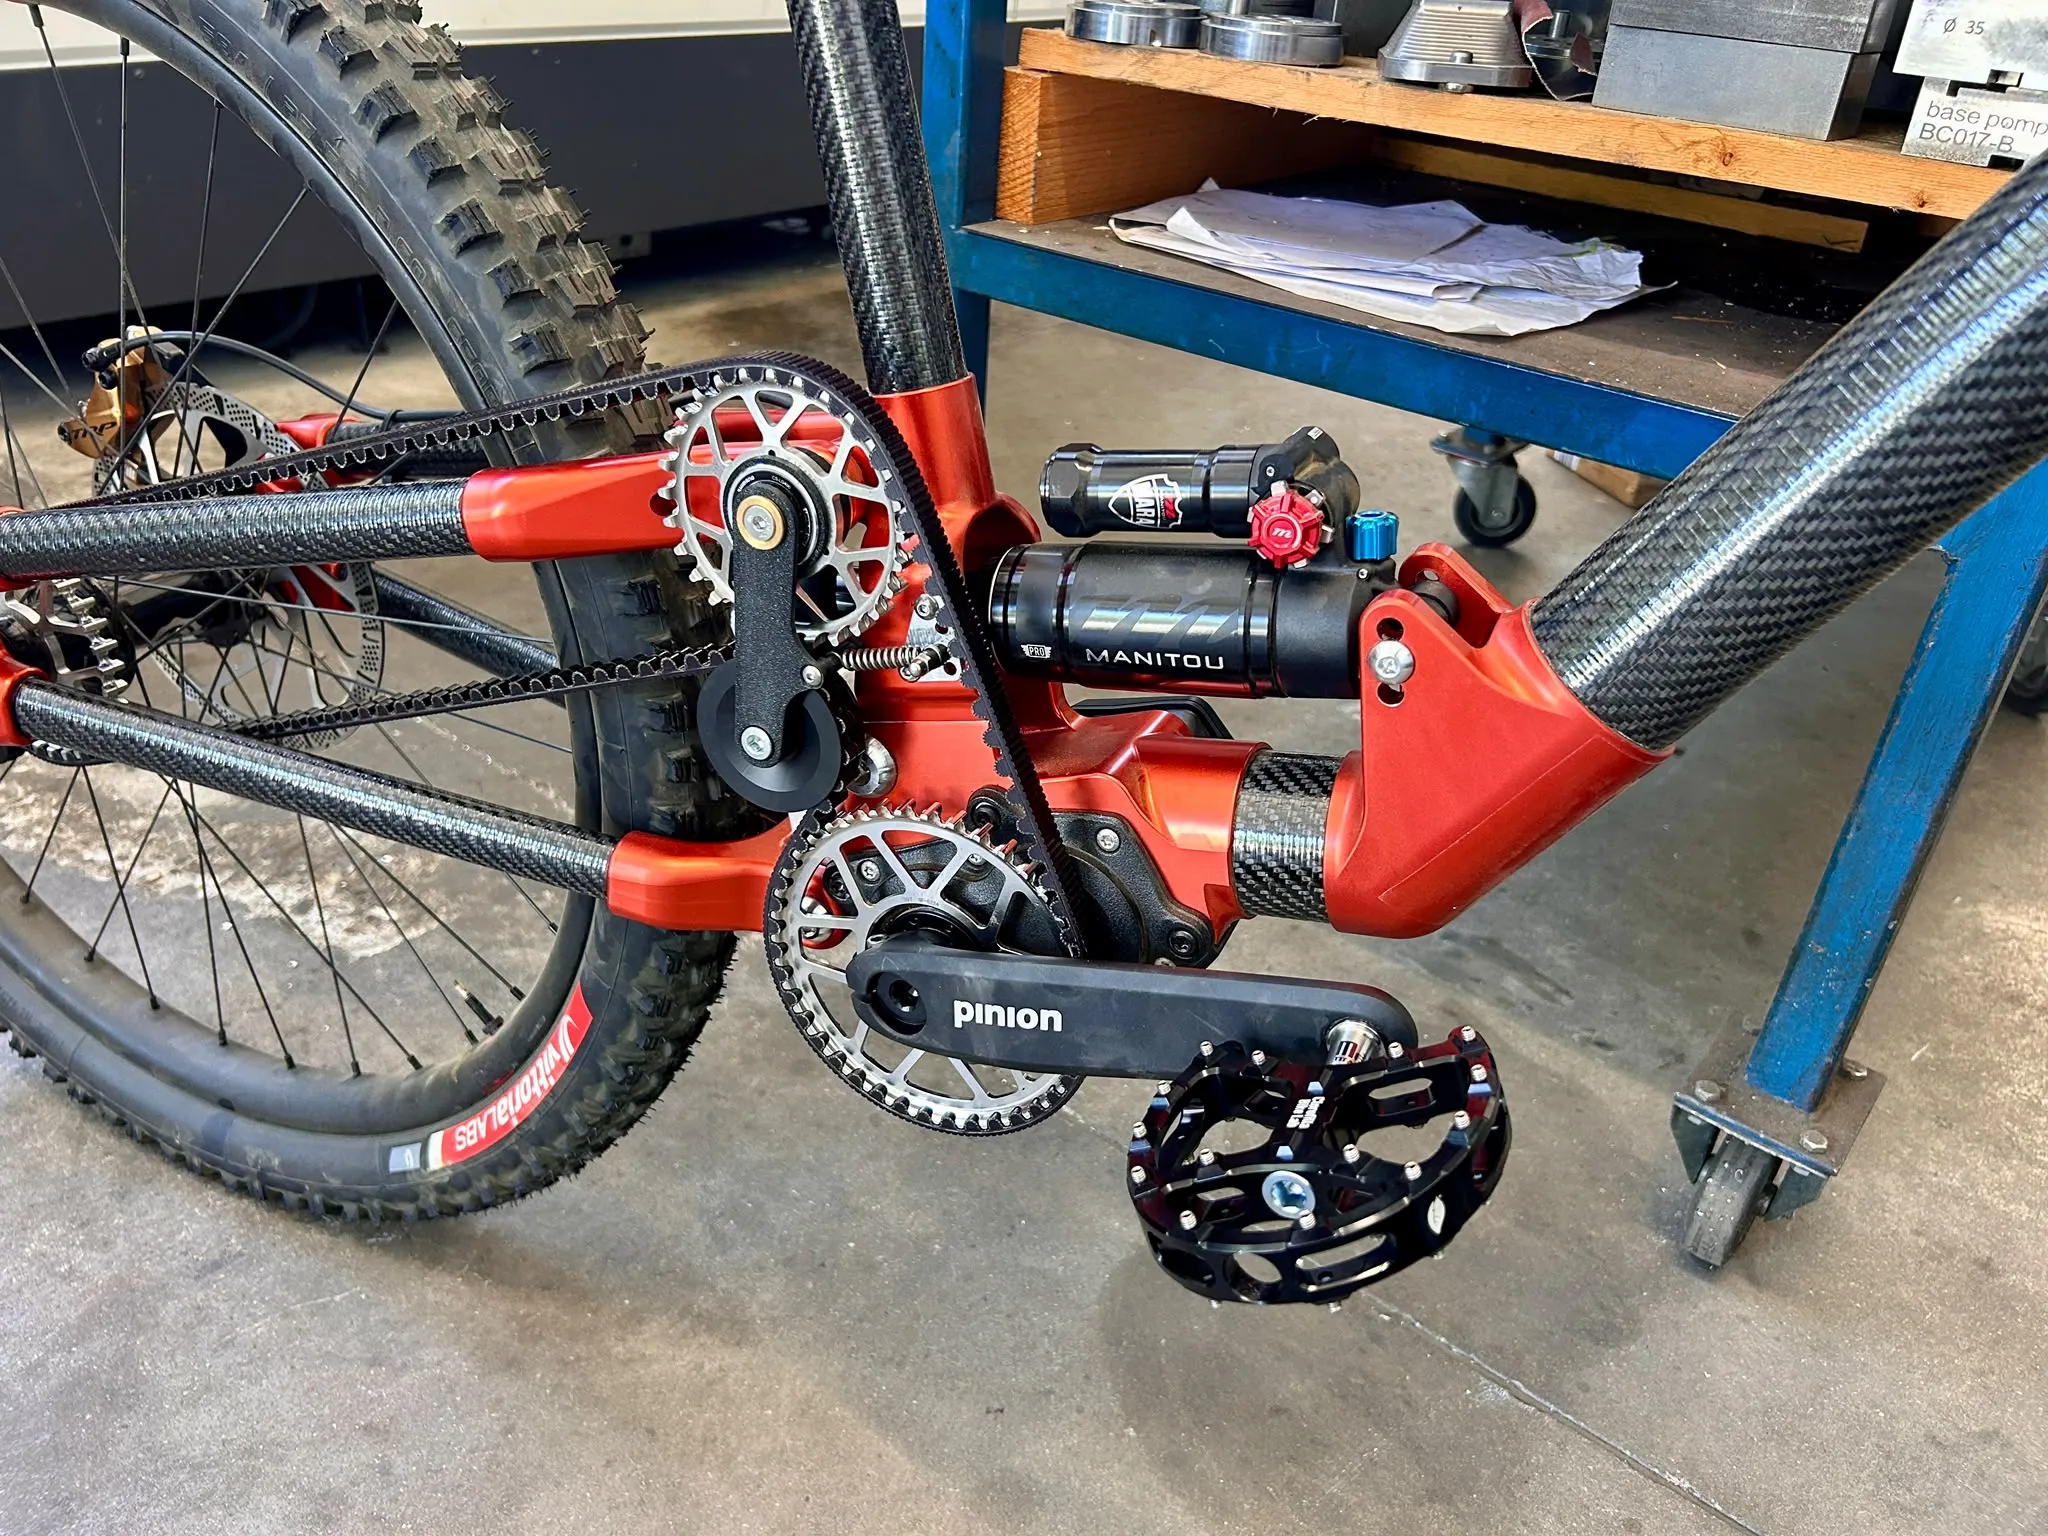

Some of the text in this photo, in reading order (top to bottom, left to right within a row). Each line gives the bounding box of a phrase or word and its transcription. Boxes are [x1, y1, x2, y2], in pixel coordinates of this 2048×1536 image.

[1964, 20, 1986, 35] 35
[1926, 100, 2048, 139] base pomp
[1918, 122, 2015, 154] BC017-B
[1028, 645, 1046, 657] PRO
[1085, 648, 1225, 670] MANITOU
[953, 999, 1063, 1032] pinion
